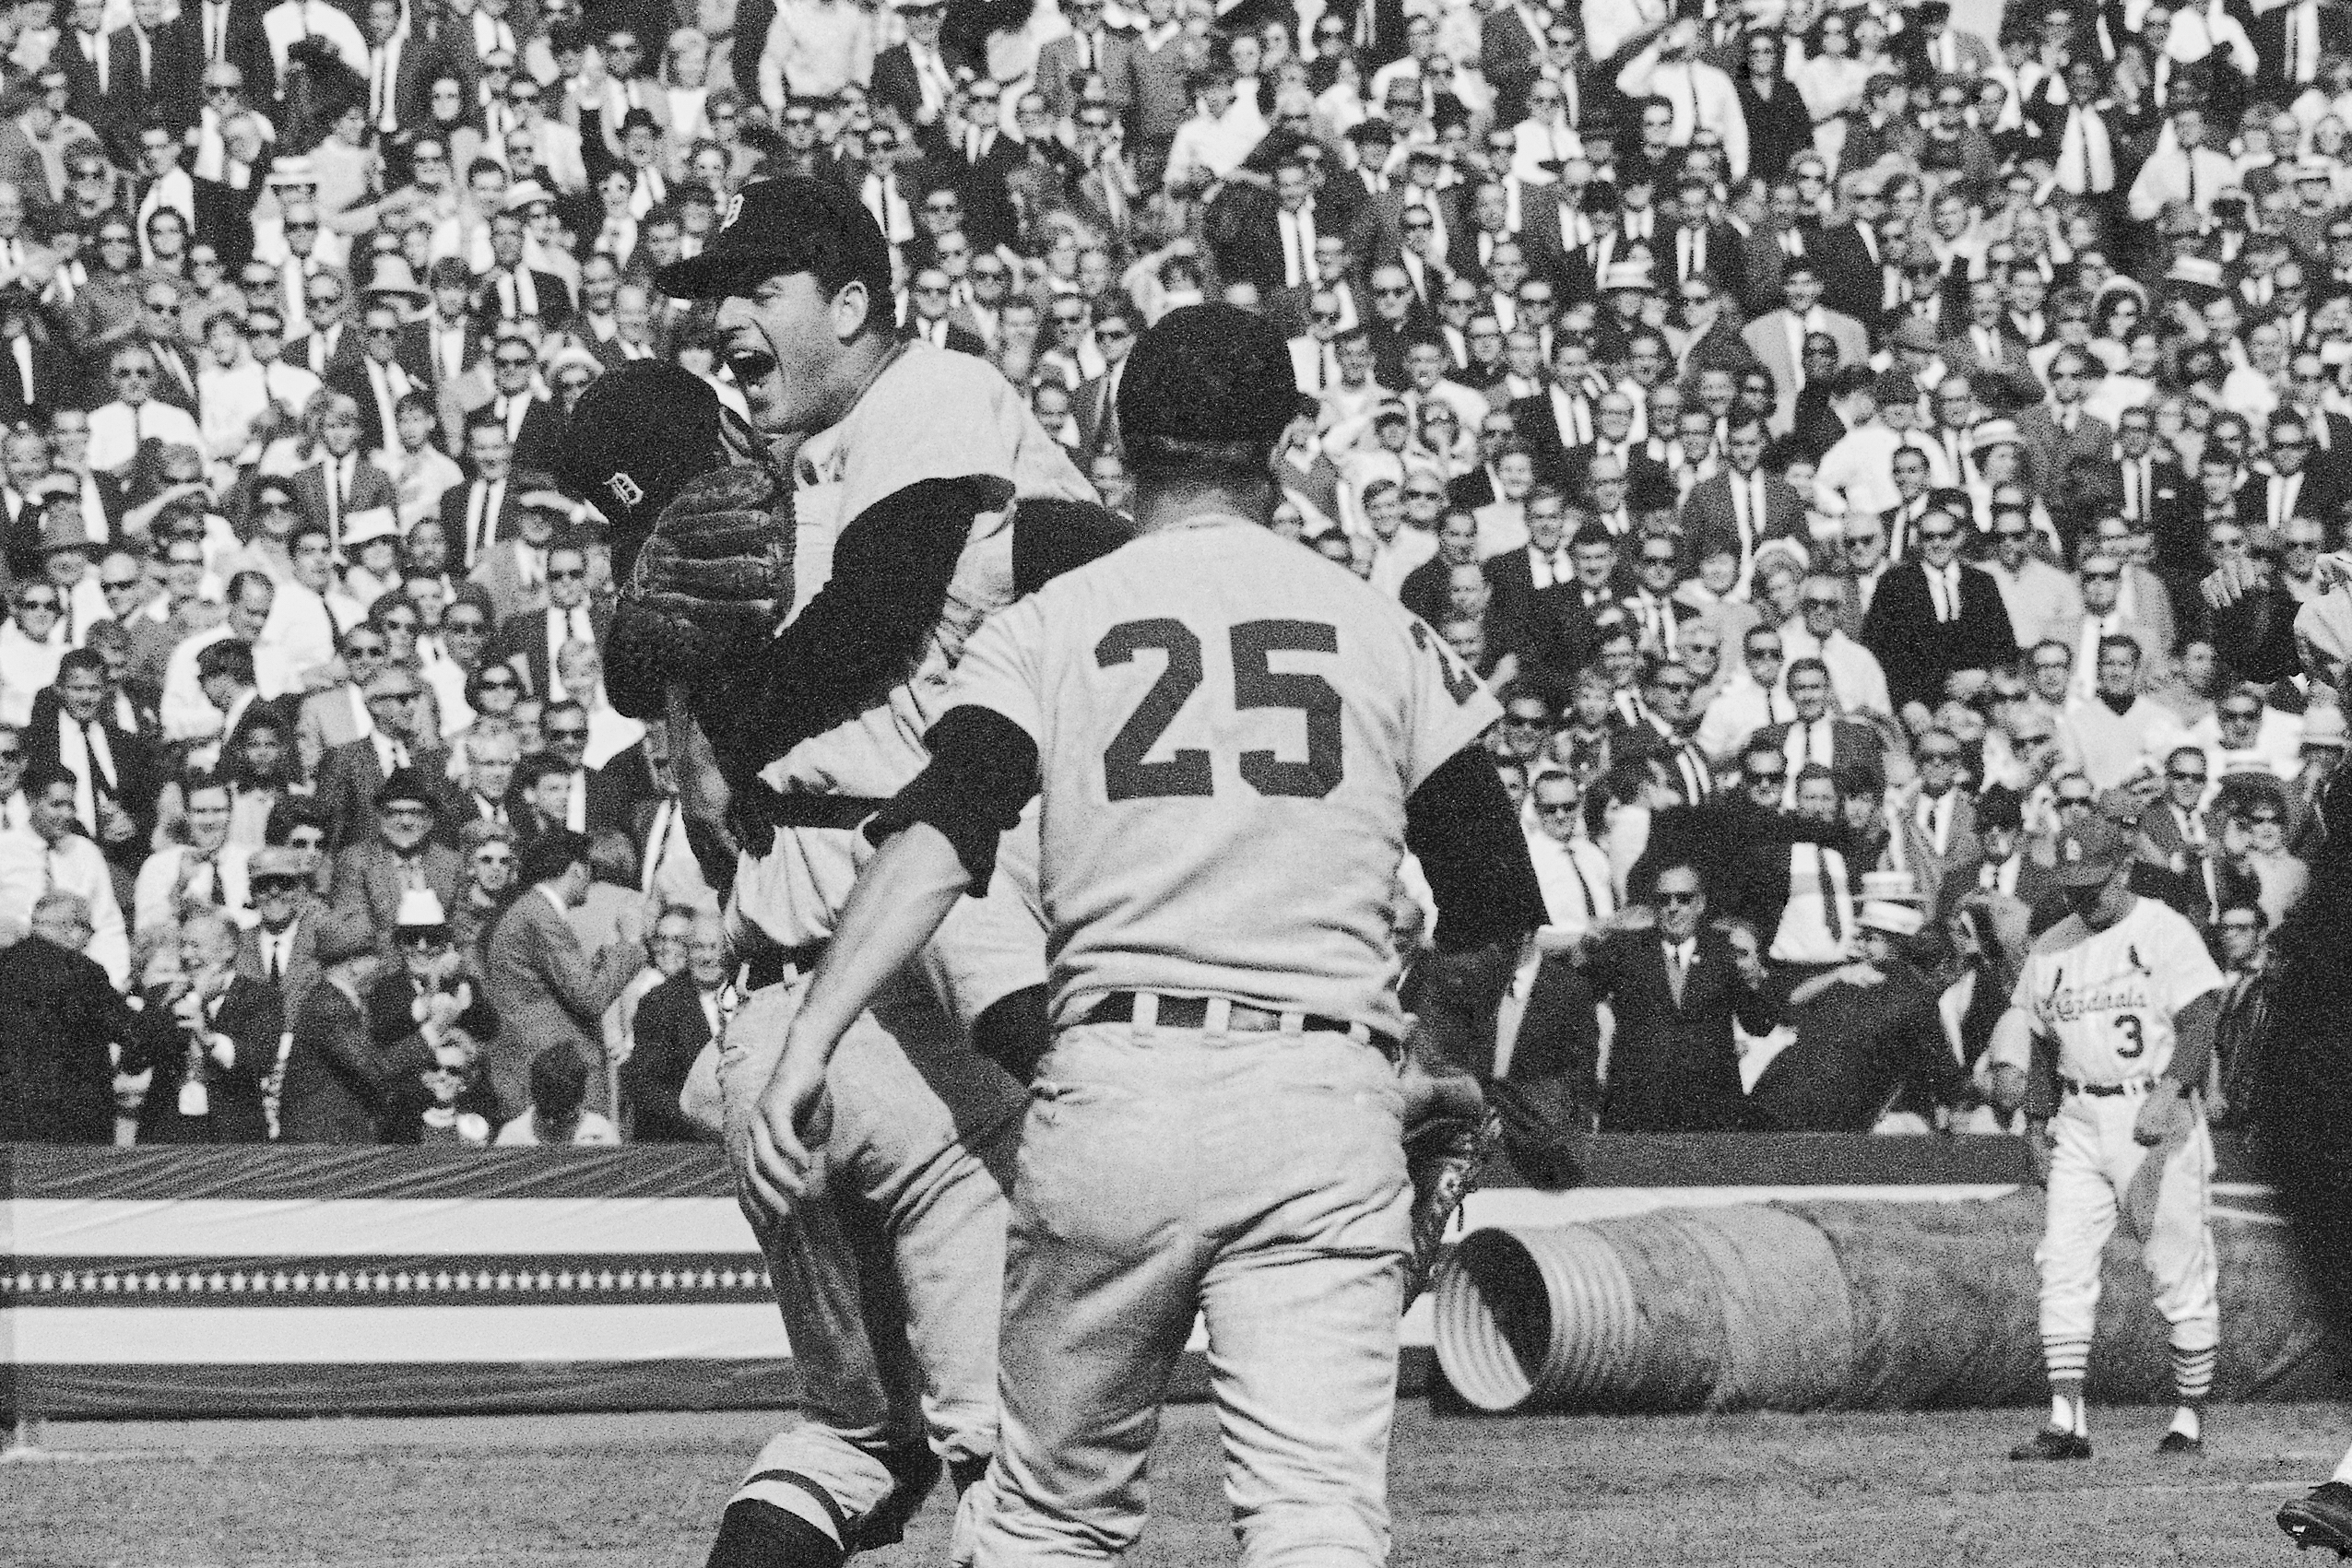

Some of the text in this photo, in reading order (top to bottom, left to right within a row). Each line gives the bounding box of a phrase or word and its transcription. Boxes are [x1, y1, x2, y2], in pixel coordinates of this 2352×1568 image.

[602, 471, 644, 513] D
[1094, 618, 1344, 803] 25
[2114, 1014, 2145, 1059] 3
